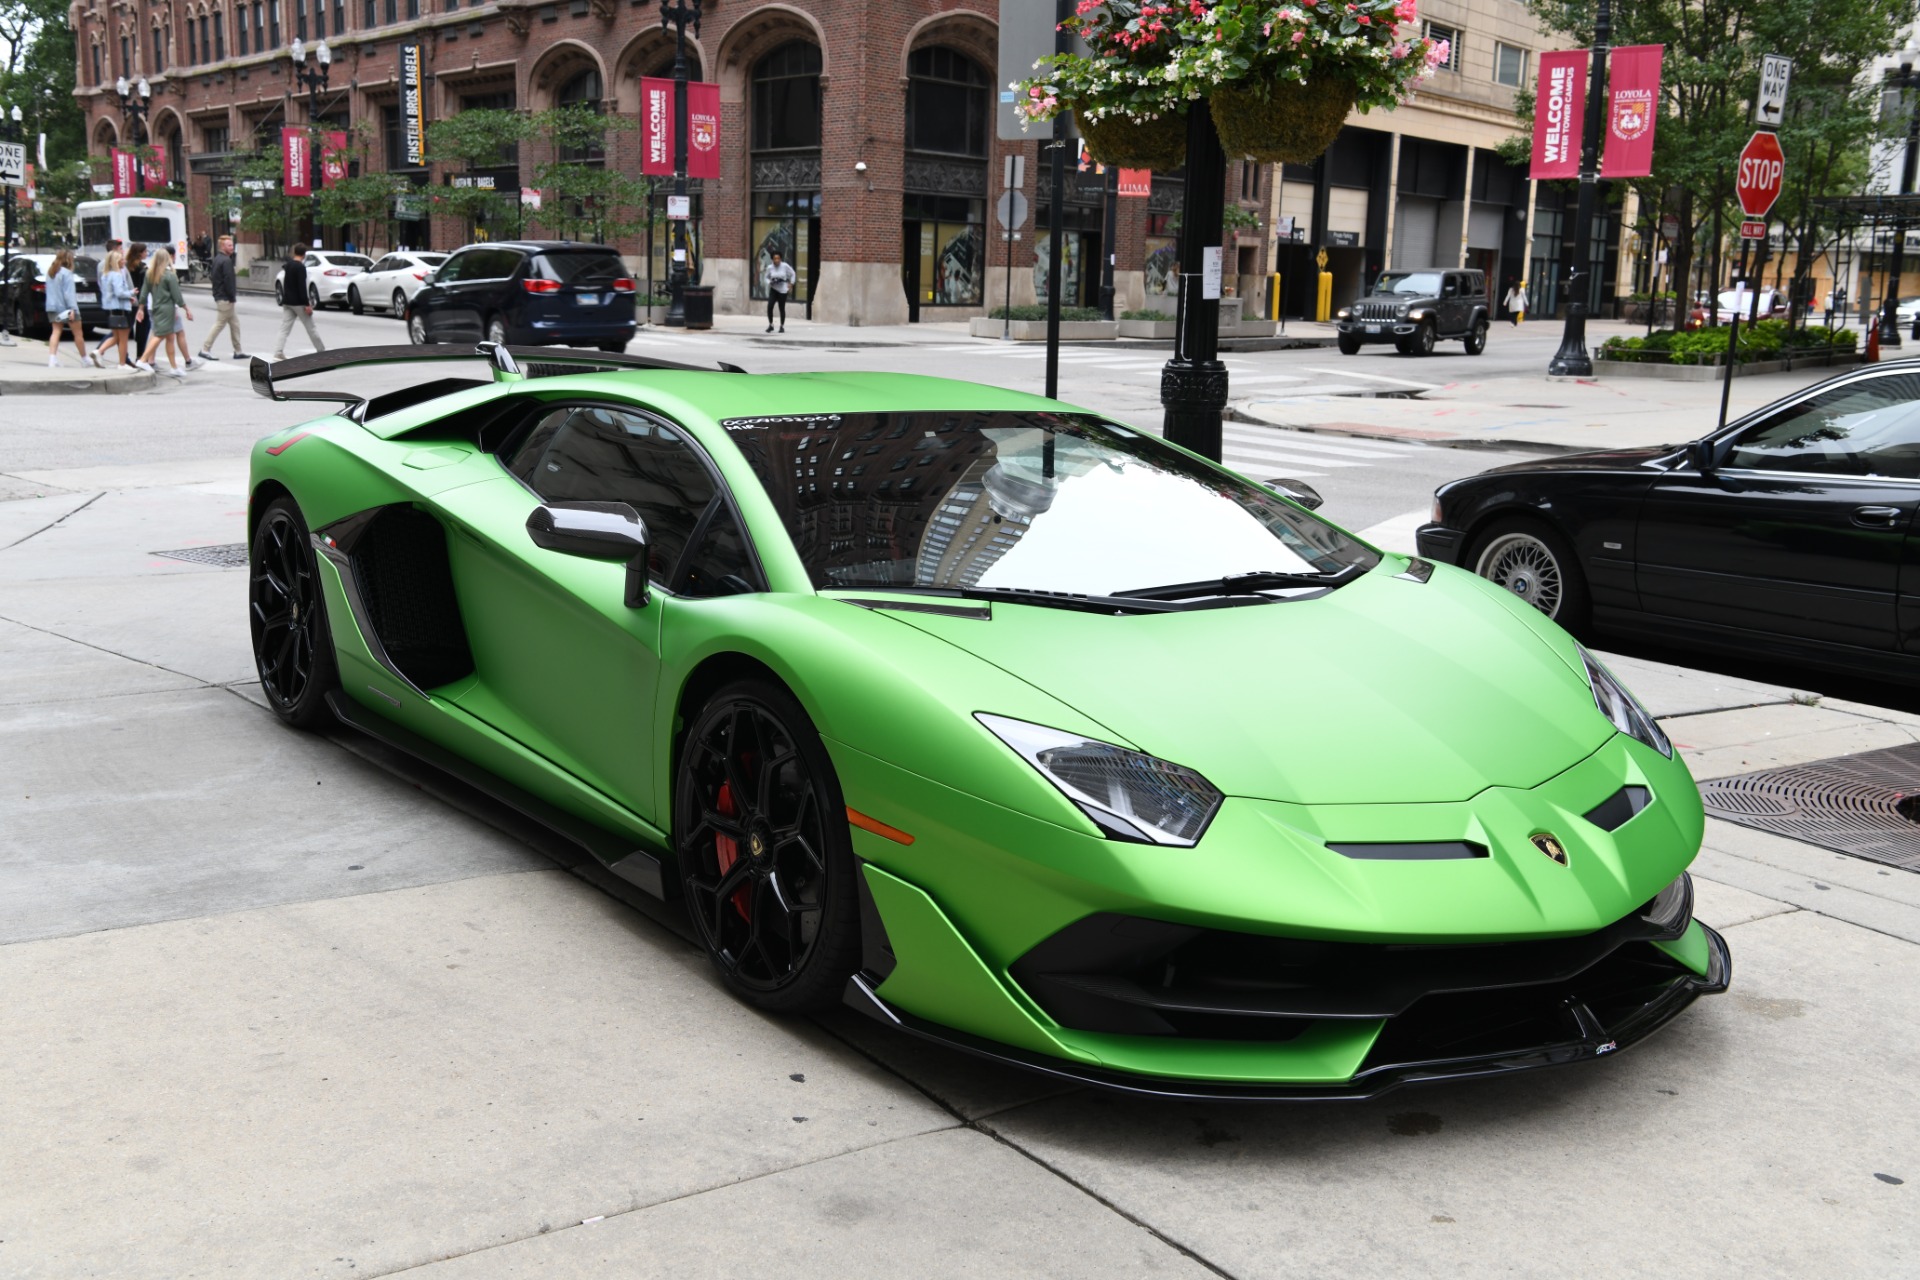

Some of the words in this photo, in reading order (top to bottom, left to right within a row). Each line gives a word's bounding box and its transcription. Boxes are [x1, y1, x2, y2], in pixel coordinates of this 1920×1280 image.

[404, 46, 418, 86] BAGELS
[1767, 62, 1787, 80] ONE
[1565, 67, 1574, 103] CAMPUS
[1615, 89, 1651, 99] LOYOLA
[1764, 81, 1785, 98] WAY
[650, 90, 661, 163] WELCOME
[692, 113, 716, 122] LOYOLA
[1544, 67, 1565, 163] WELCOME
[1563, 104, 1571, 134] TOWER
[407, 118, 419, 164] EINSTEIN
[1560, 135, 1569, 163] WATER
[117, 154, 126, 195] WELCOME
[289, 137, 299, 187] WELCOME
[1740, 157, 1781, 190] STOP
[1118, 184, 1150, 195] LUMA
[1742, 224, 1752, 235] ALL
[1753, 225, 1764, 236] WAY
